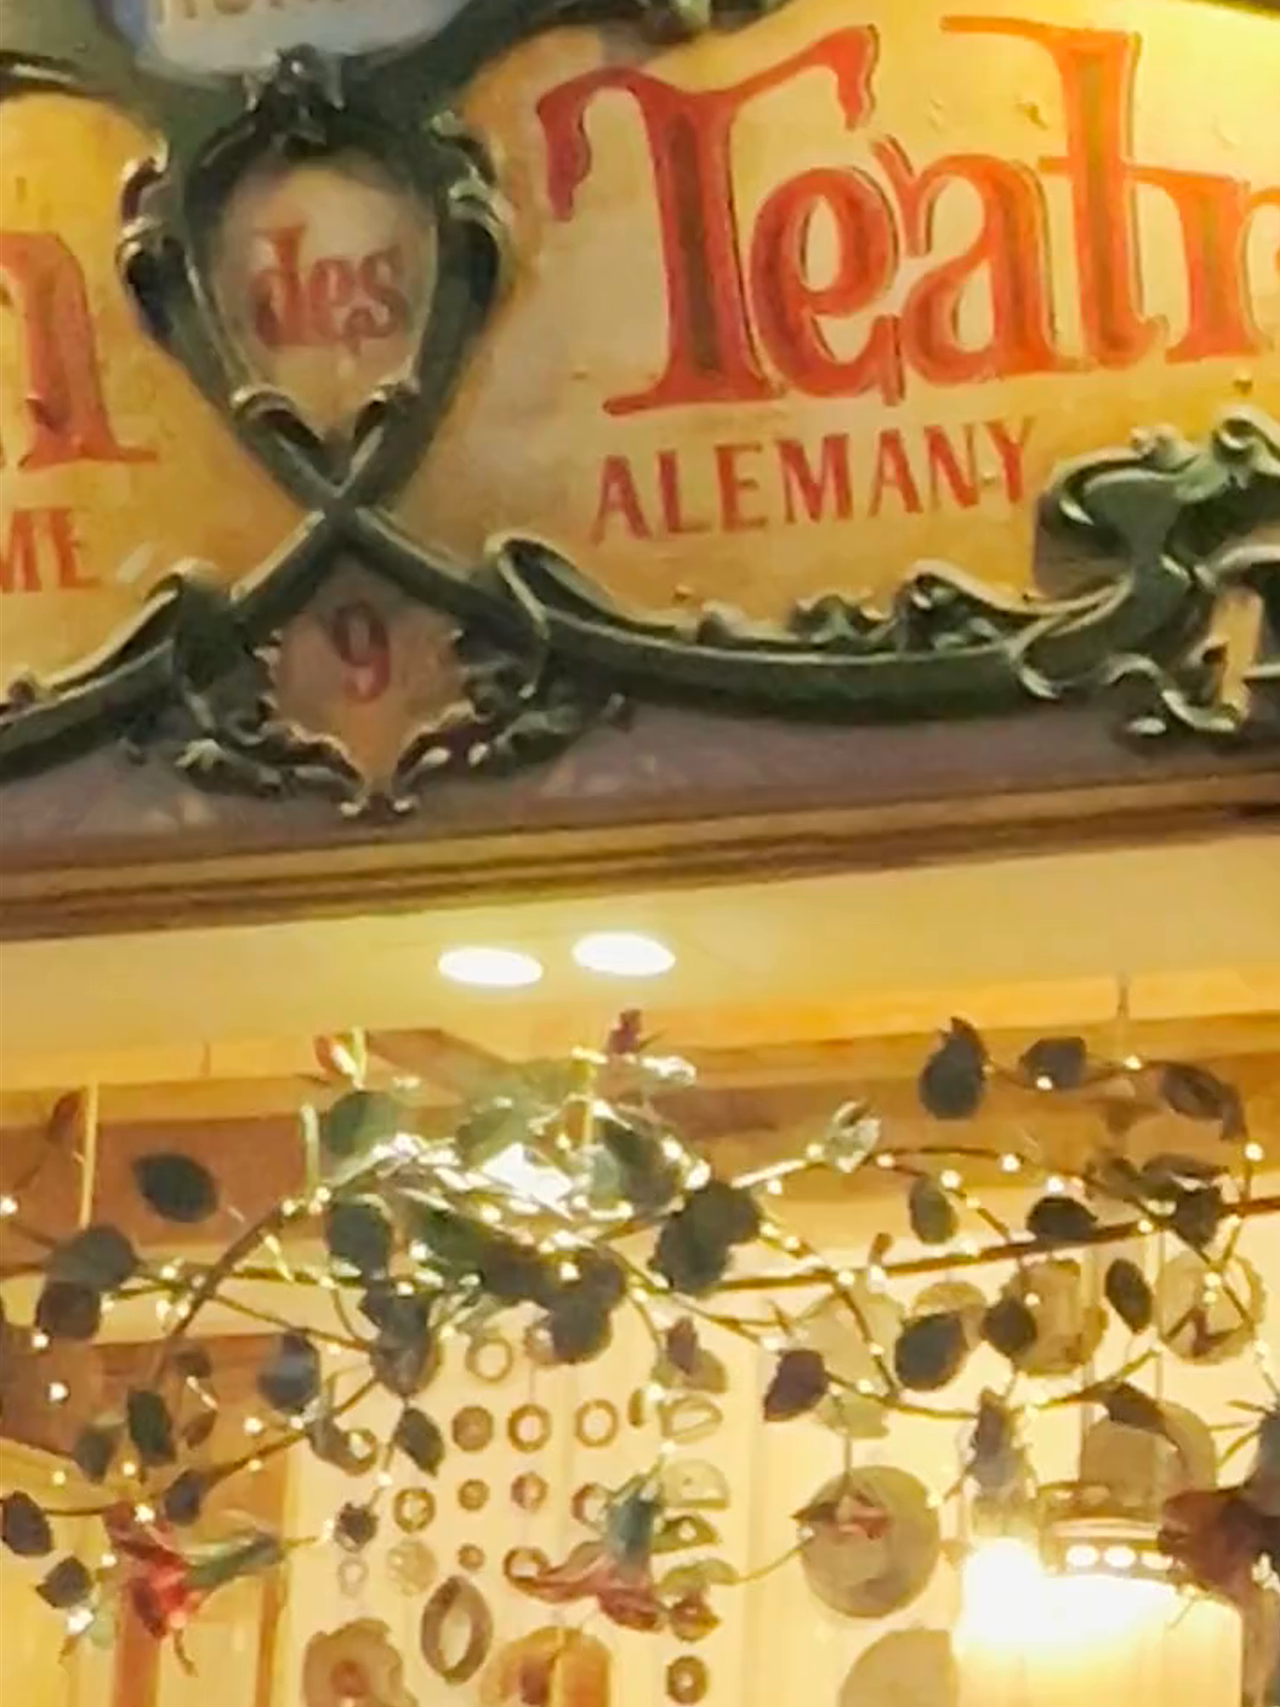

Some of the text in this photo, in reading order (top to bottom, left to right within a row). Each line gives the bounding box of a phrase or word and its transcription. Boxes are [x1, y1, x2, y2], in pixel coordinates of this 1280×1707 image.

[250, 225, 410, 359] des
[590, 415, 1040, 545] ALEMANY
[332, 596, 393, 705] 9
